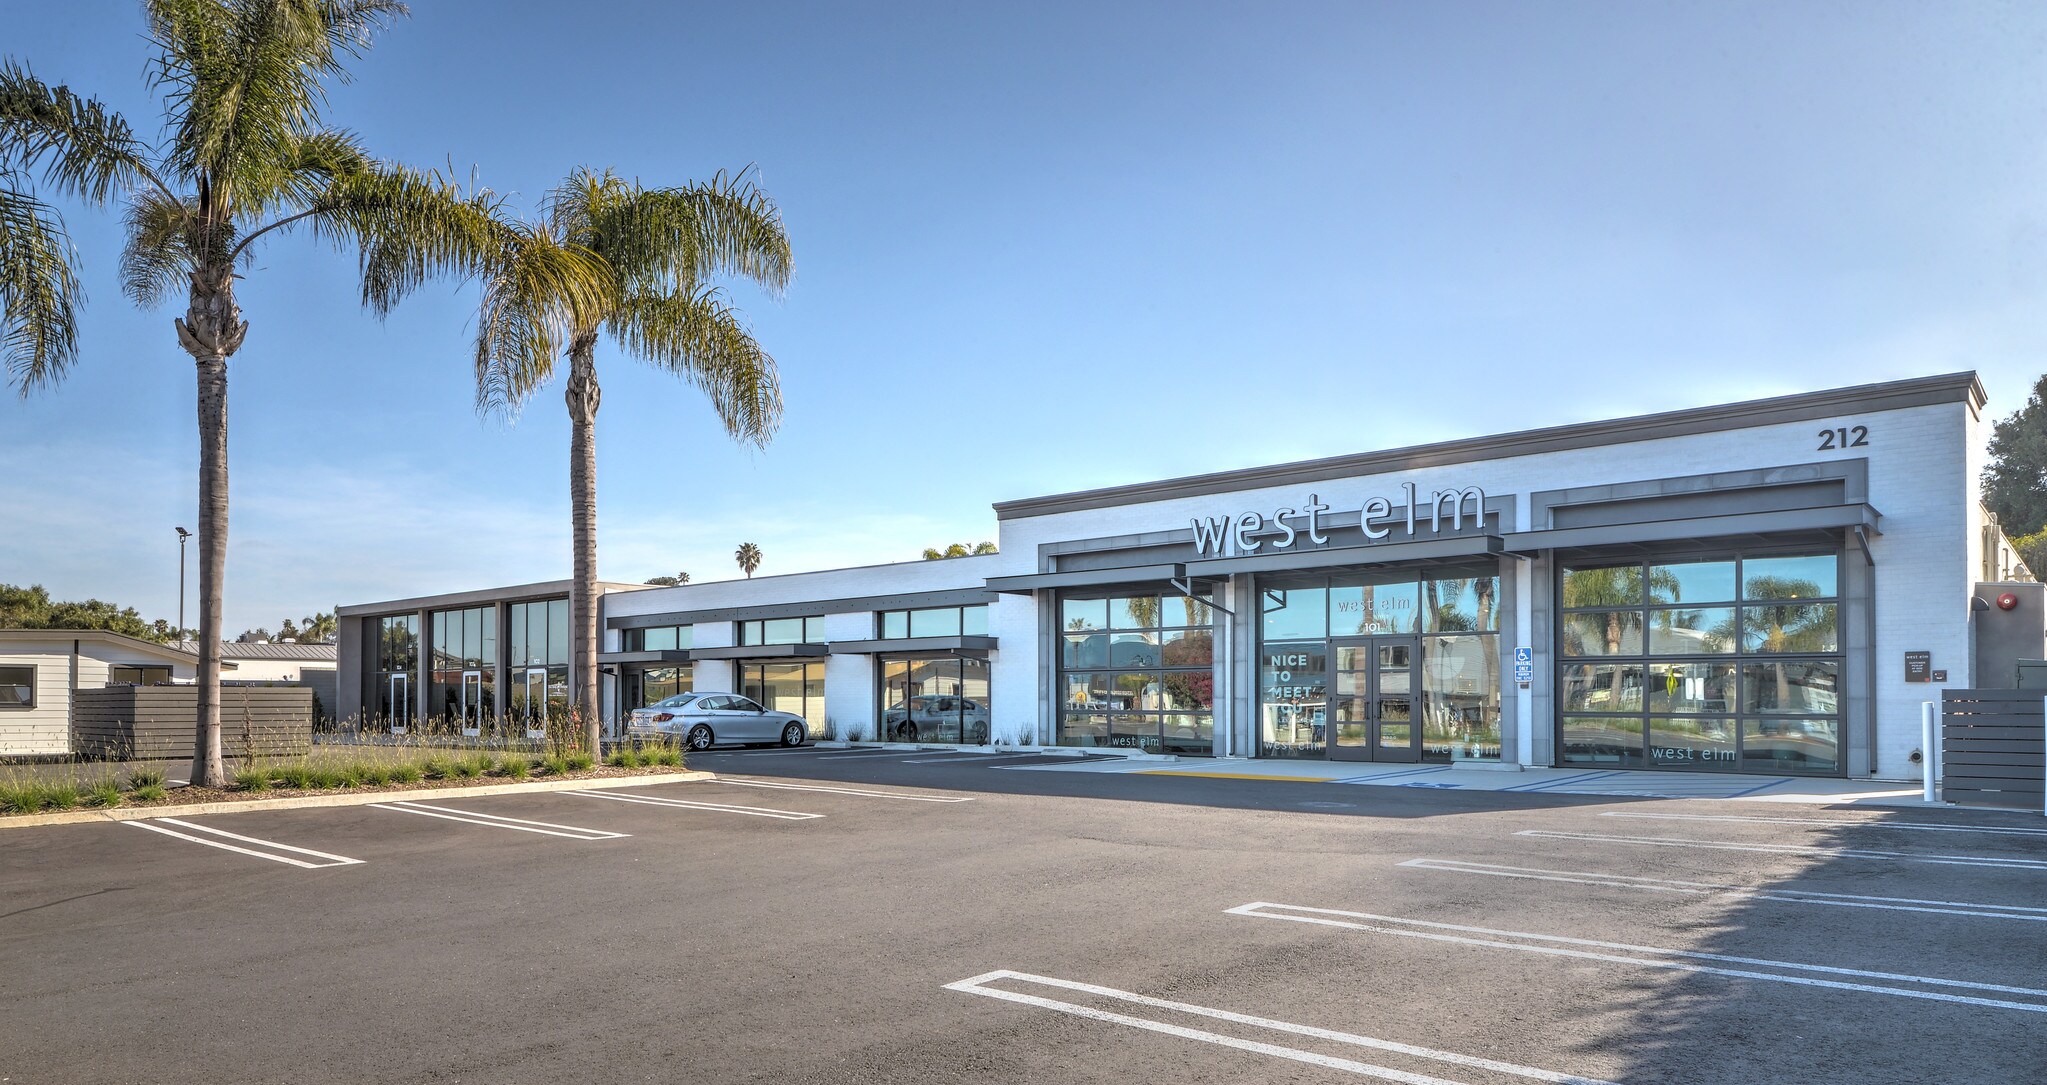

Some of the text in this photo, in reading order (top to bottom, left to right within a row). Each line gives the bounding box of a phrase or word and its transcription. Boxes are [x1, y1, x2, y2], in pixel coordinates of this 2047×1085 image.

[1817, 425, 1869, 451] 212
[1190, 482, 1486, 554] west elm
[1338, 597, 1410, 612] west elm
[1364, 622, 1380, 632] 101
[1271, 654, 1307, 667] NICE
[1271, 671, 1291, 682] TO
[1271, 686, 1312, 698] MEET
[1112, 736, 1159, 747] west elm
[1264, 740, 1321, 751] west elm
[1651, 747, 1735, 760] west elm
